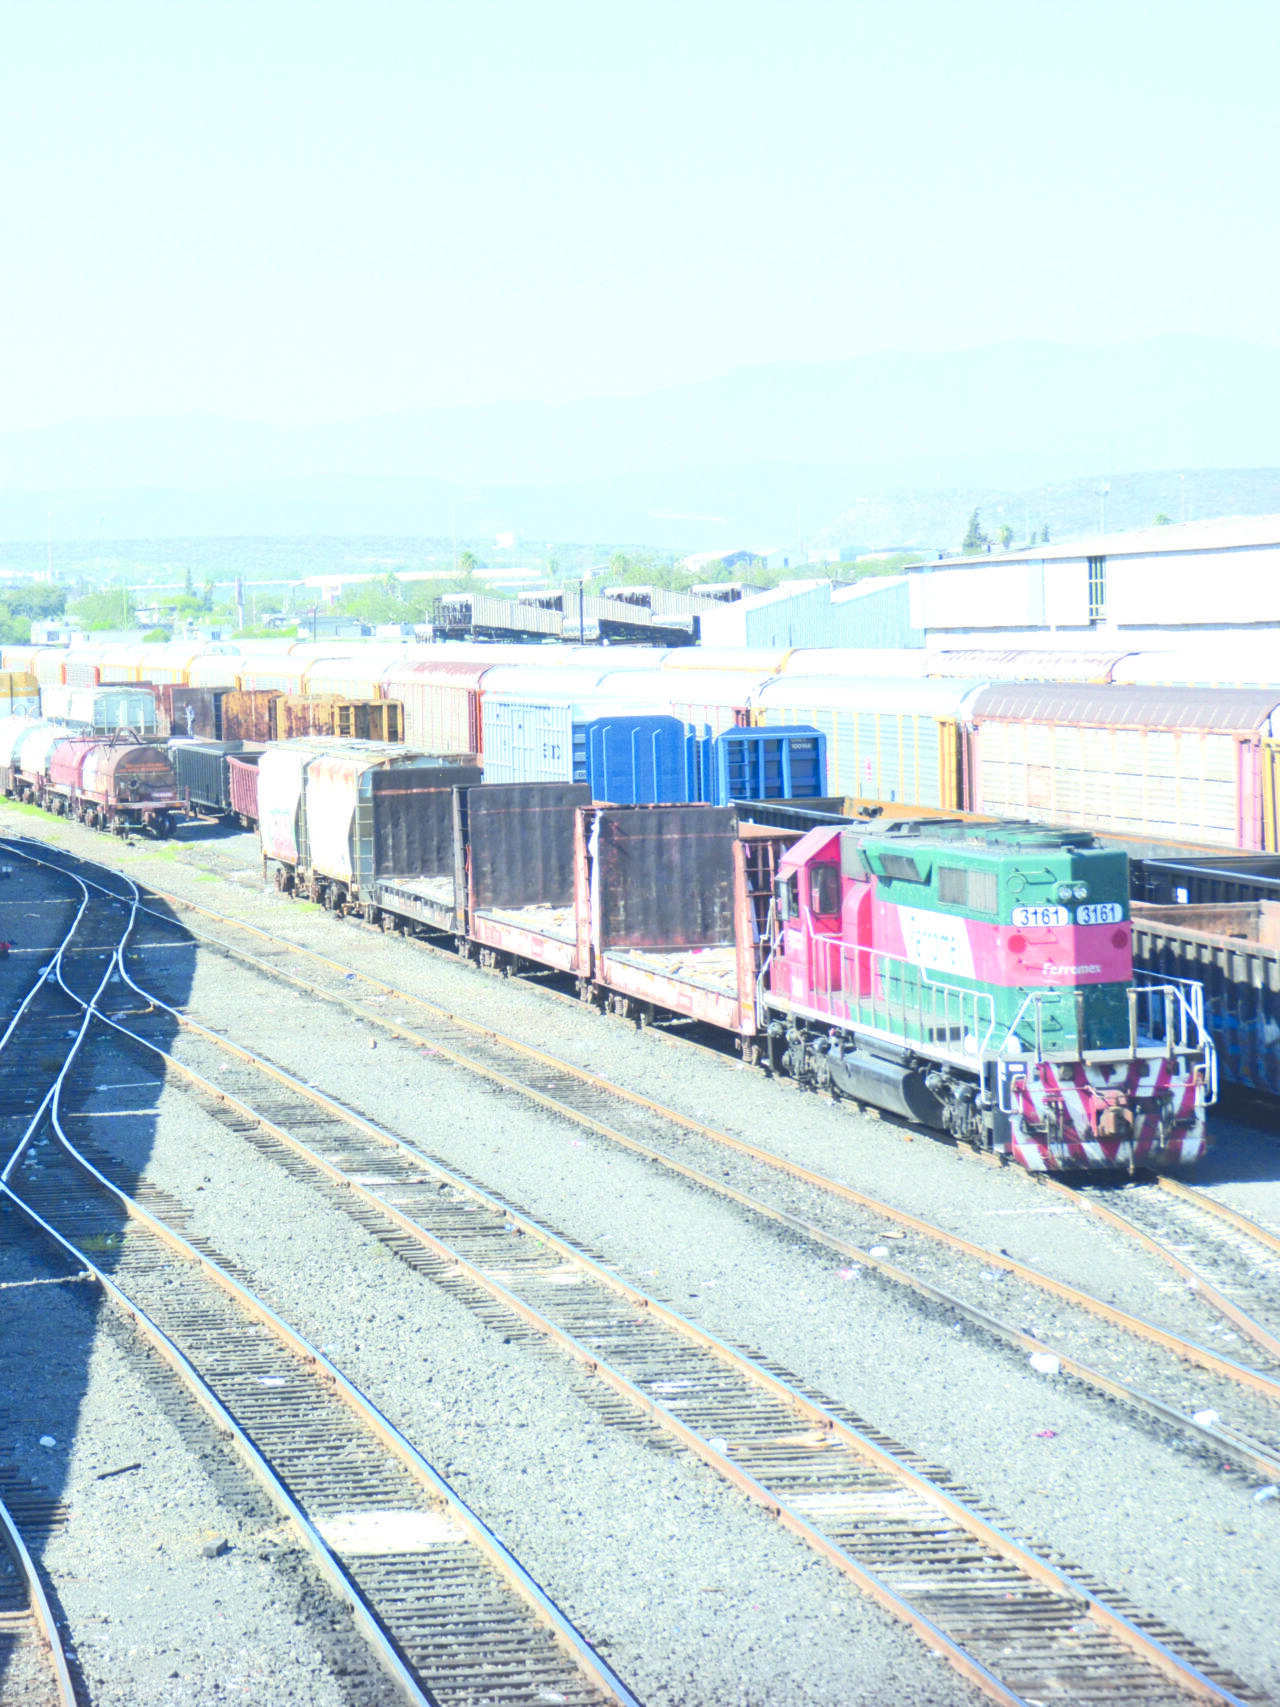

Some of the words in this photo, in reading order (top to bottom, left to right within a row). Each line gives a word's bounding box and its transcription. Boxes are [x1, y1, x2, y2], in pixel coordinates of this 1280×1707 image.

[1020, 908, 1060, 925] 3161
[1082, 905, 1116, 923] 3161
[1042, 963, 1101, 975] Ferromex
